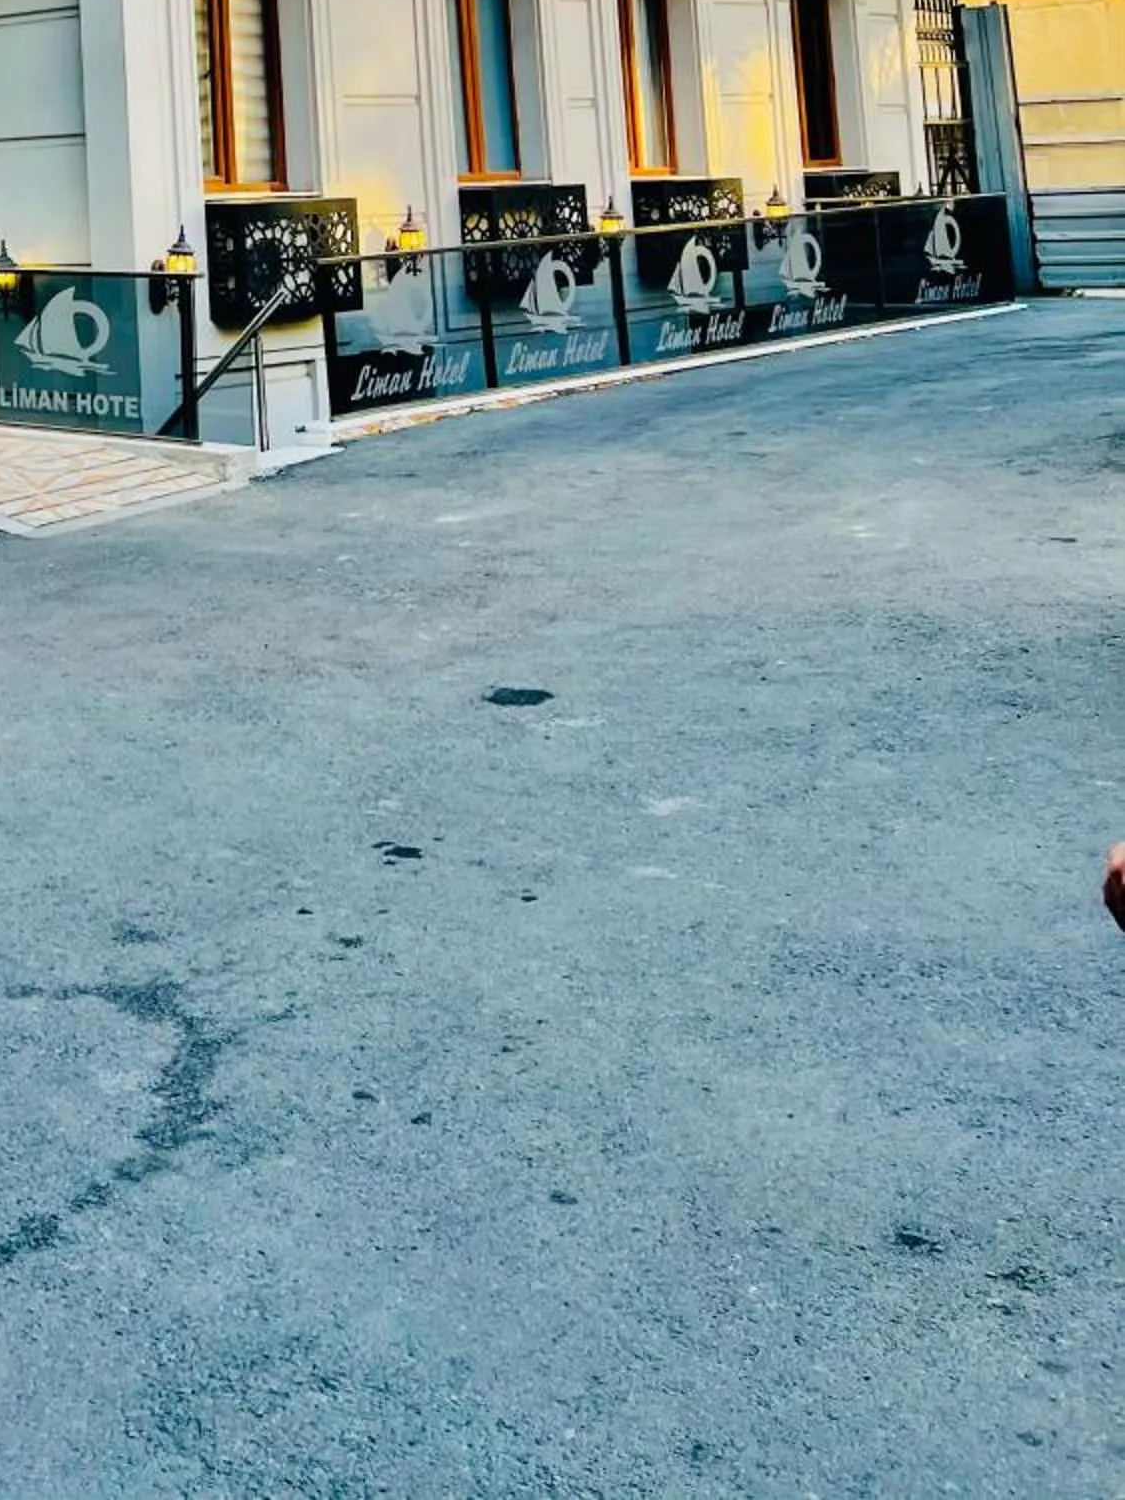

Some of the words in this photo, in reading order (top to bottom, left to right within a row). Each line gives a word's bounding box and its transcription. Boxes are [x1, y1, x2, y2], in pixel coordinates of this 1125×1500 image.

[504, 341, 558, 375] Liman
[562, 329, 610, 367] Hotel
[350, 364, 413, 400] Liman
[416, 351, 471, 391] Hotel
[75, 392, 140, 419] HOTE
